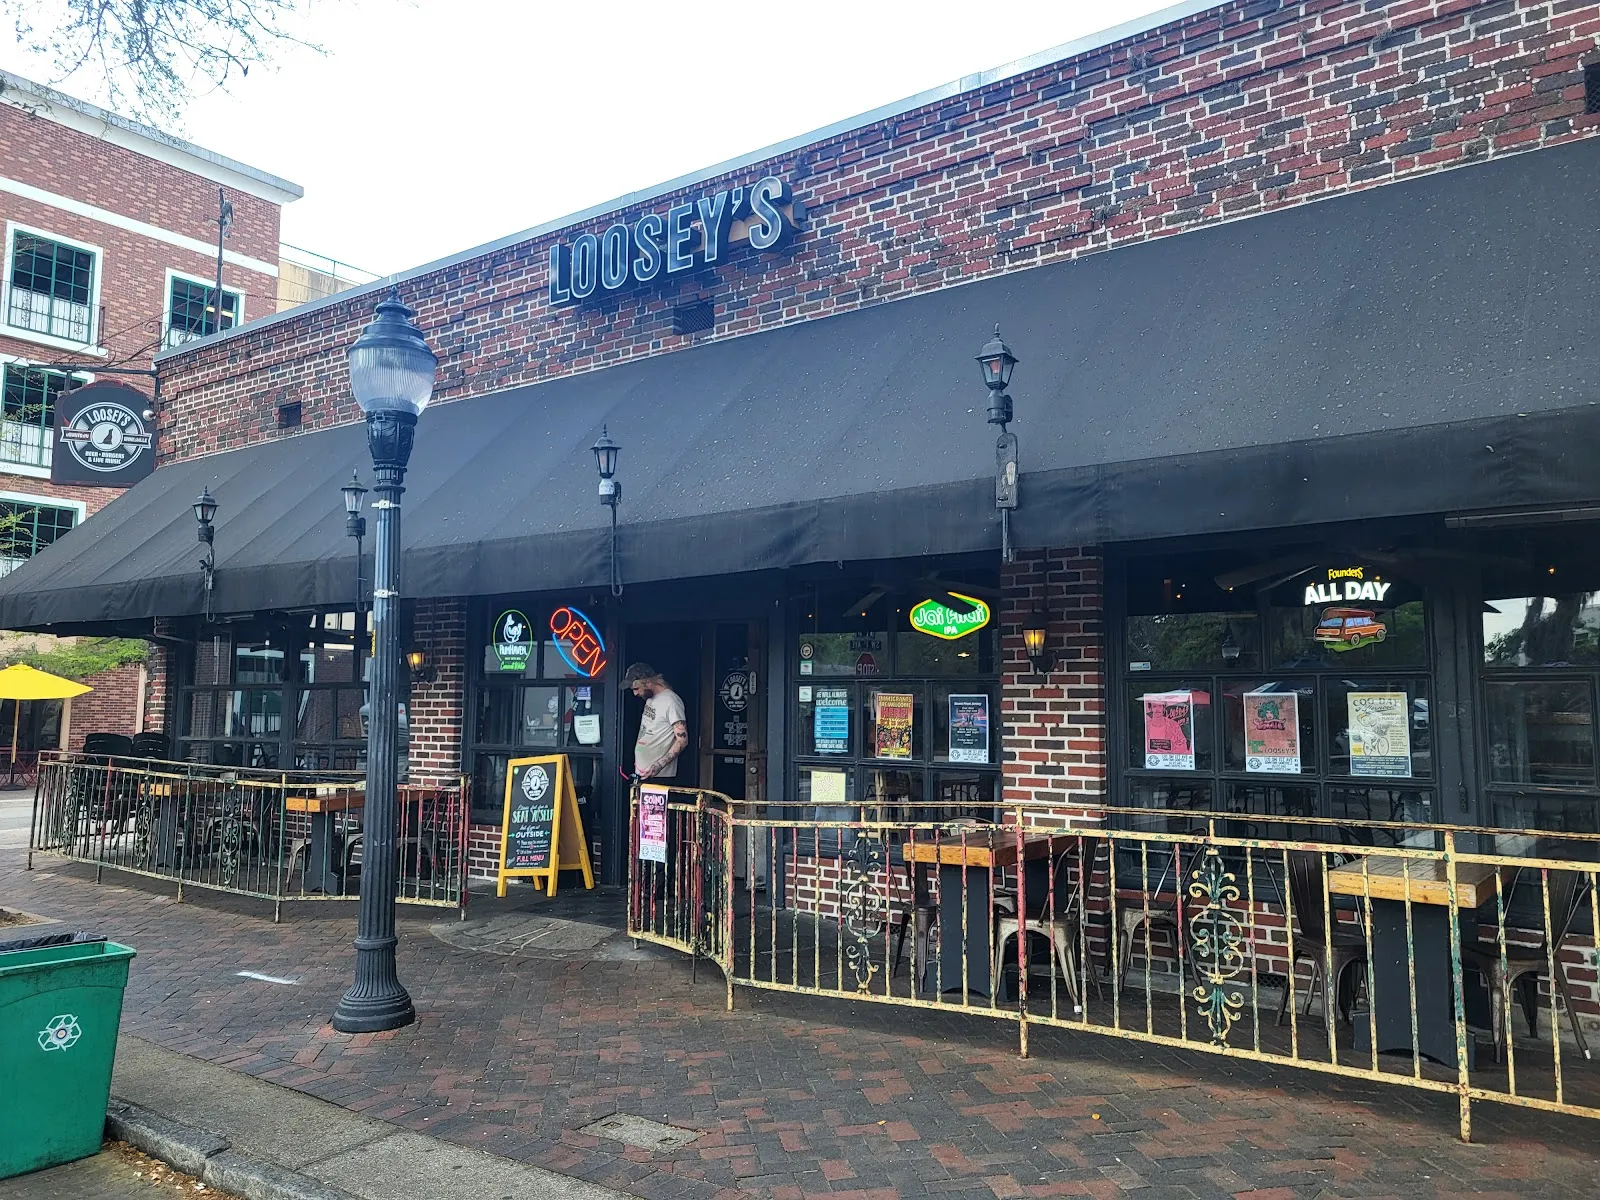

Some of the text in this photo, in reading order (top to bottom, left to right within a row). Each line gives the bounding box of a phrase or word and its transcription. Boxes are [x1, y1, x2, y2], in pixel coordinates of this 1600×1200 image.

[548, 176, 785, 306] LOOSEY'S
[86, 409, 131, 426] LOOSEY'S
[1328, 567, 1363, 580] Founders
[1304, 581, 1391, 606] ALL DAY
[913, 607, 945, 627] Jai
[943, 626, 958, 635] IPA
[550, 608, 607, 677] OPEN
[815, 698, 847, 706] welcome
[880, 707, 908, 718] HERE!
[643, 794, 665, 806] SOUND
[511, 810, 529, 824] SEAT
